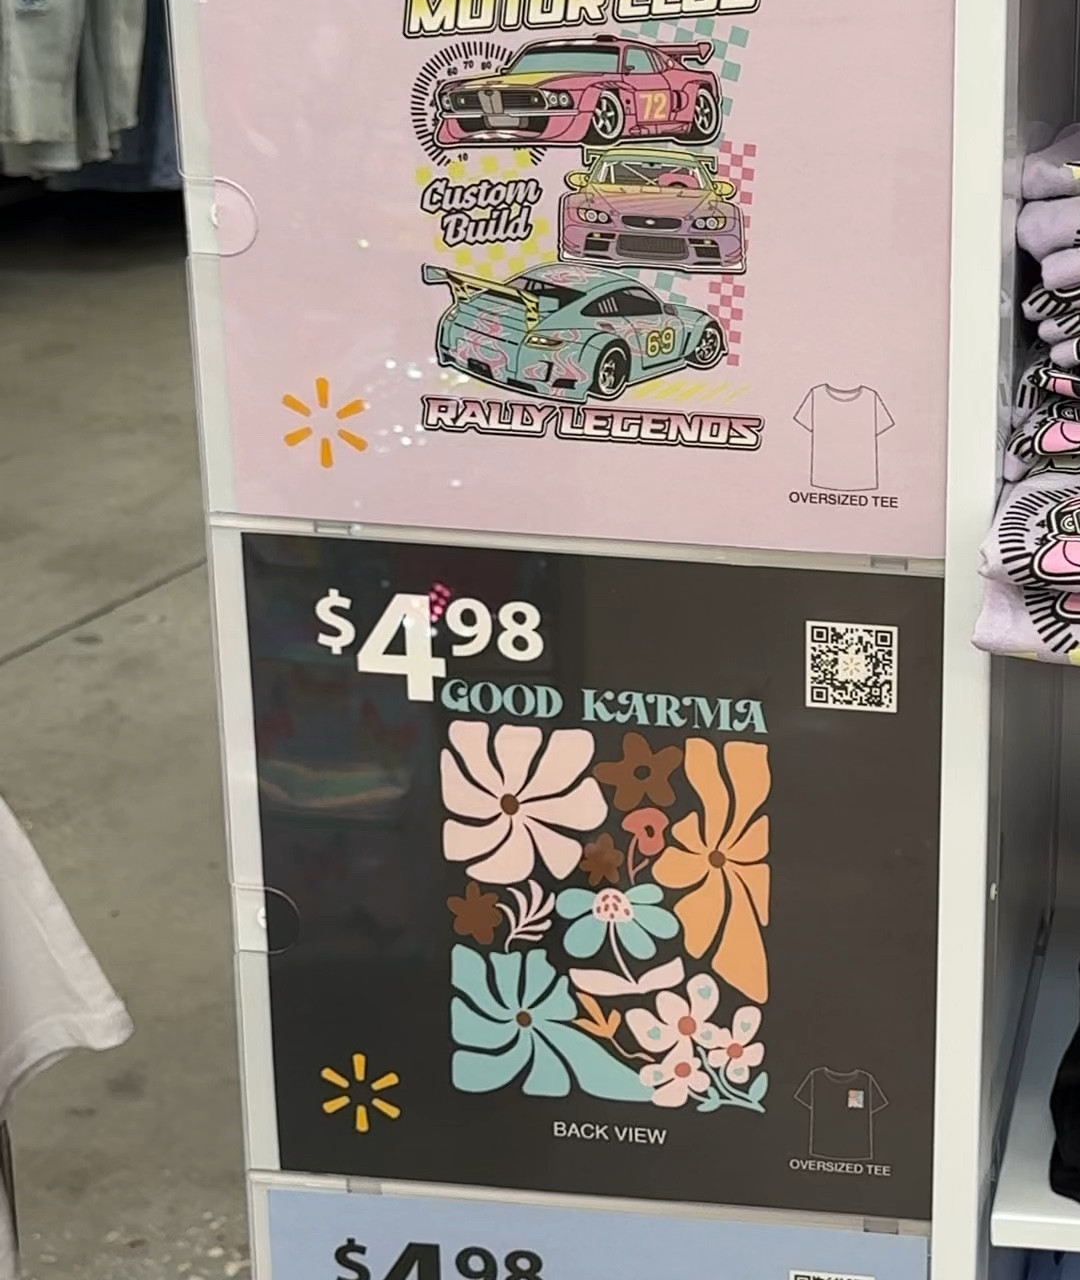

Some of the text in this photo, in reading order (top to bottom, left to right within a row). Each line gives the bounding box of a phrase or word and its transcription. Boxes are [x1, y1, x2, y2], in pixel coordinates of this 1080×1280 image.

[639, 92, 668, 120] 72
[421, 178, 542, 215] Custom
[442, 208, 534, 246] Build
[645, 325, 675, 358] 69
[420, 396, 764, 450] RALLY LEGENDS
[788, 490, 899, 509] OVERSIZED TEE
[440, 678, 769, 734] GOOD KARMA
[553, 1121, 667, 1145] BACK VIEW
[789, 1158, 891, 1177] OVERSIZED TEE
